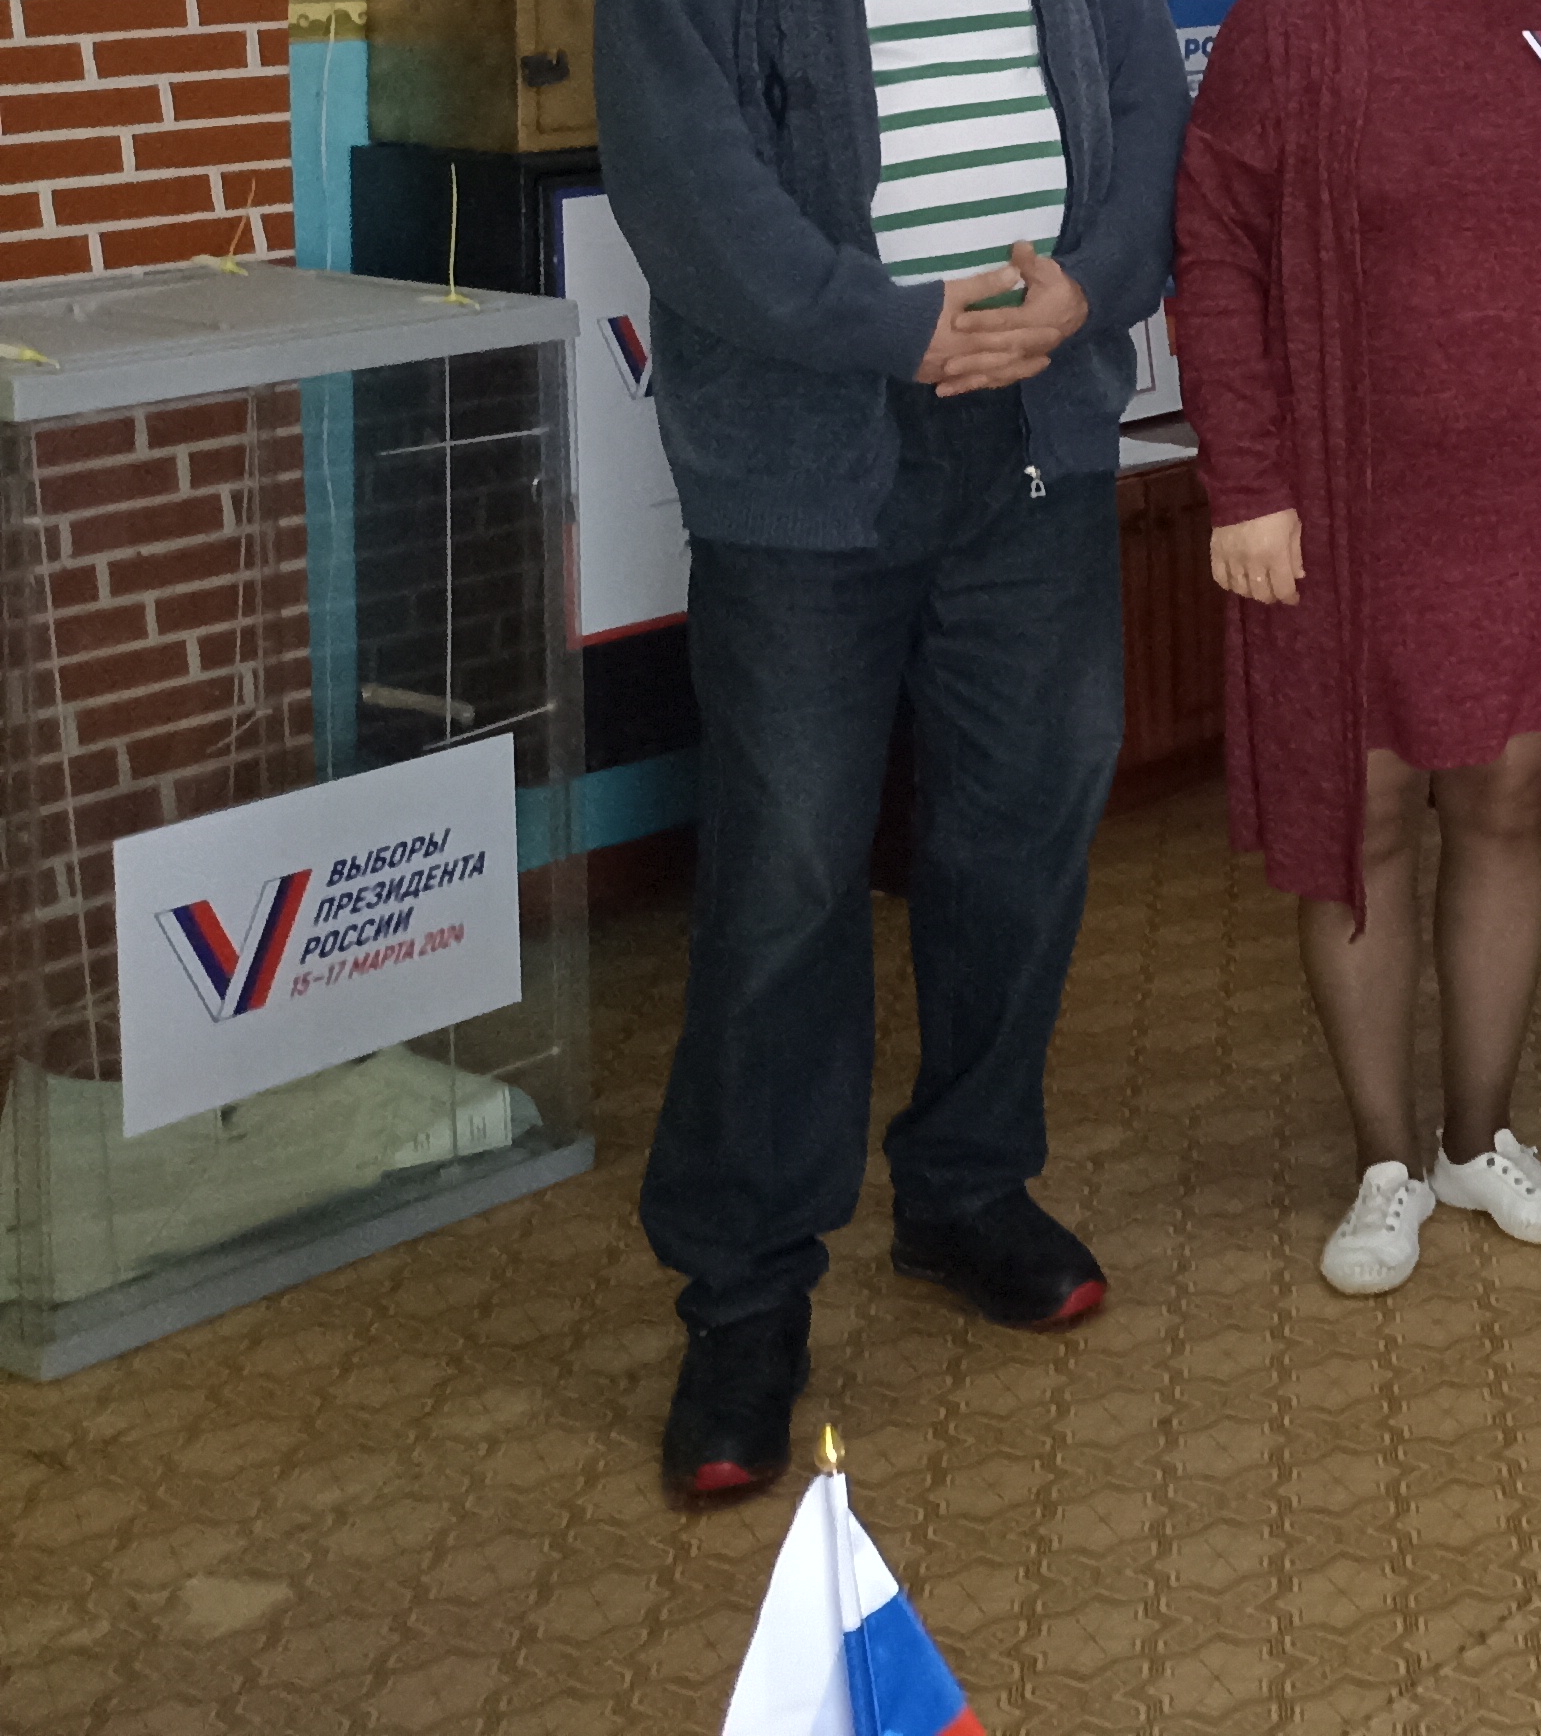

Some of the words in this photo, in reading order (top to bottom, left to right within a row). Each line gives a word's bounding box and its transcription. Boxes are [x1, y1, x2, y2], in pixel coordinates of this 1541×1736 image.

[325, 827, 452, 888] ВЫБОРЫ
[312, 850, 487, 927] ПРЕЗИДЕНТА
[299, 905, 415, 965] РОССИИ
[347, 938, 416, 980] МАРТА
